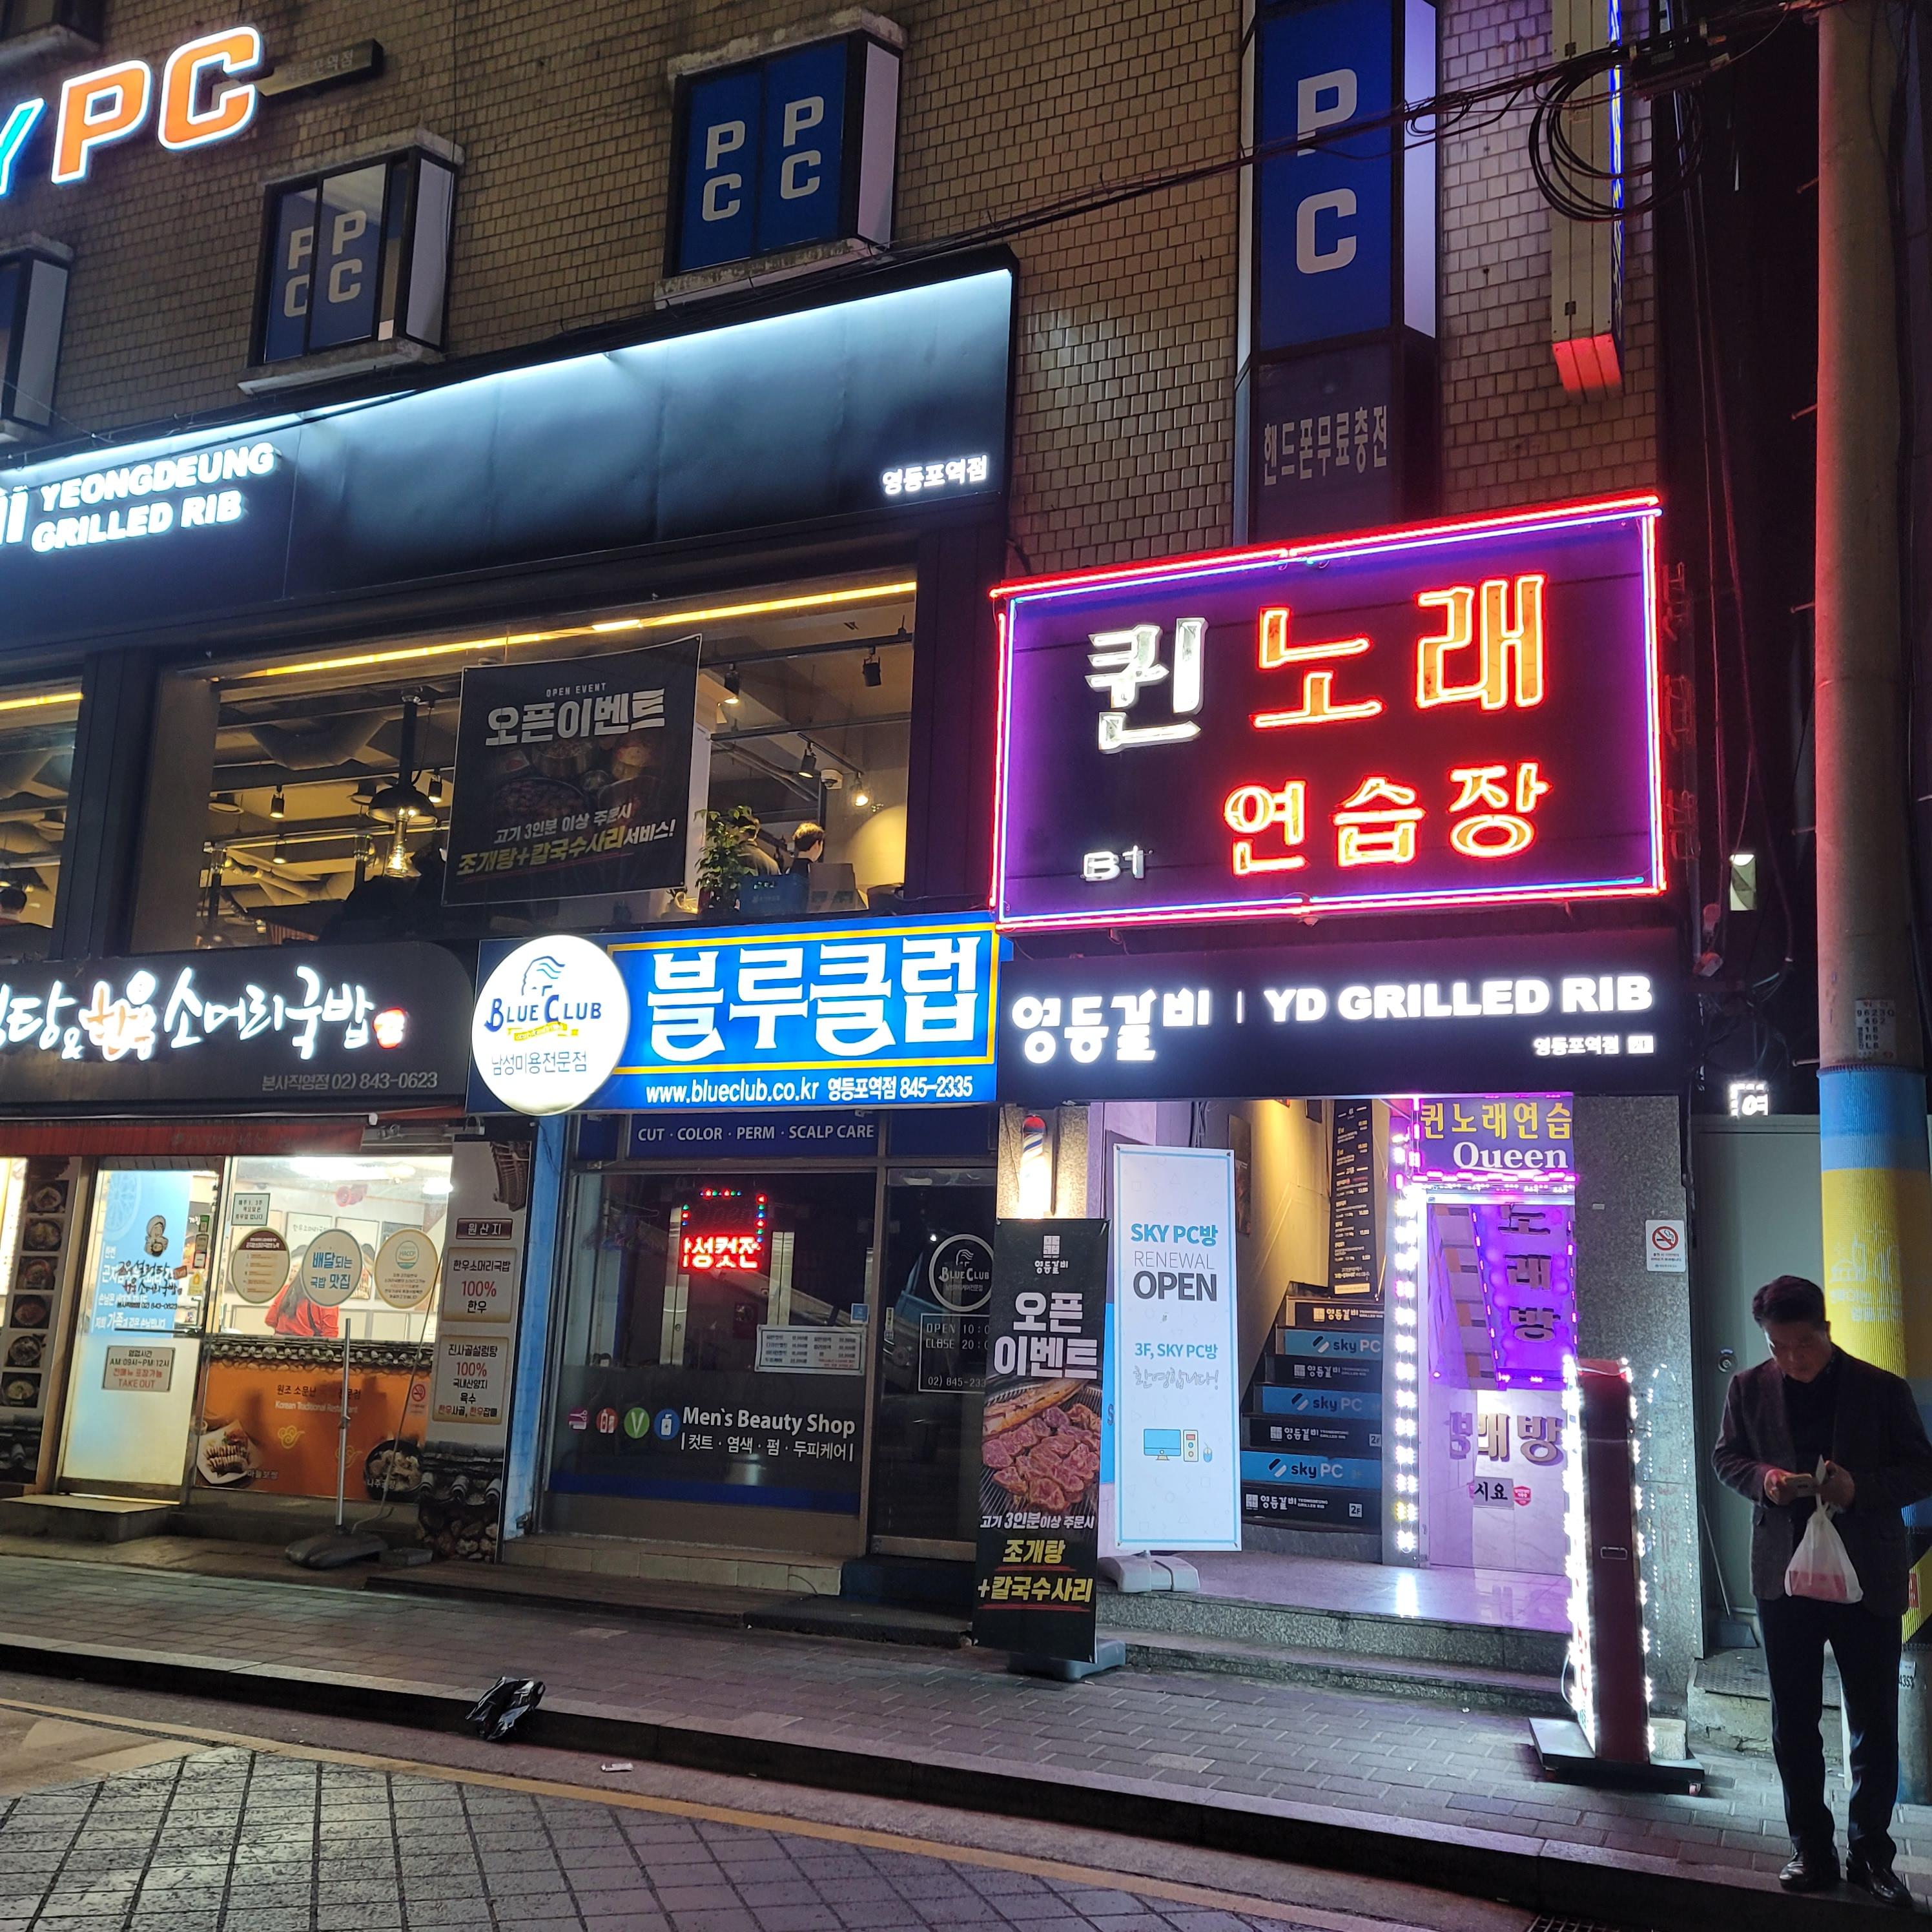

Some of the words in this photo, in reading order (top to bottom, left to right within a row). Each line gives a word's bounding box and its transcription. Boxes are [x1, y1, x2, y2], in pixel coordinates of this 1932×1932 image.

[52, 26, 261, 184] PC
[1263, 405, 1387, 486] 핸드폰무료충전
[40, 442, 276, 511] YEONGDEUNG
[882, 455, 987, 495] 영등포역점
[30, 501, 173, 553] GRILLED
[181, 489, 243, 528] RIB
[1085, 617, 1208, 754] 퀸
[1248, 571, 1548, 732] 노래
[546, 687, 571, 698] OPEN
[575, 683, 606, 694] EVENT
[485, 688, 665, 746] 오픈이벤트
[494, 827, 521, 844] 고기
[524, 818, 557, 839] 3인분
[562, 814, 590, 832] 이상
[593, 803, 632, 827] 주문시
[1223, 759, 1554, 877] 연습장
[1081, 845, 1149, 882] B1
[647, 937, 980, 1062] 블루클럽
[1264, 988, 1327, 1023] YD
[1338, 978, 1550, 1020] GRILLED
[1561, 976, 1652, 1013] RIB
[163, 967, 375, 1061] 소머리국밥
[491, 1051, 587, 1076] 남성미용전문점
[262, 1074, 329, 1093] 본사직영점
[332, 1074, 356, 1090] 02)
[359, 1072, 438, 1089] 843-0623
[646, 1076, 819, 1104] www.blueclub.co.kr
[827, 1076, 897, 1100] 영등포역점
[899, 1076, 973, 1099] 845-2335
[638, 1128, 665, 1142] CUT
[677, 1127, 723, 1141] COLOR
[736, 1127, 775, 1140] PERM
[788, 1125, 835, 1140] SCALP
[836, 1125, 874, 1138] CARE
[1454, 1141, 1568, 1169] Queen
[468, 1222, 502, 1236] 원산지
[1131, 1223, 1169, 1243] SKY
[1173, 1224, 1219, 1248] PC방
[313, 1251, 353, 1269] 배달되는
[453, 1260, 511, 1273] 한우소머리국밥
[1134, 1250, 1215, 1270] RENEWAL
[310, 1277, 327, 1289] 국밥
[329, 1273, 351, 1290] 맛집
[461, 1280, 497, 1297] 100%
[1133, 1271, 1218, 1302] OPEN
[467, 1299, 488, 1314] 한우
[1013, 1292, 1083, 1333] 오픈
[926, 1324, 956, 1334] OPEN
[963, 1324, 990, 1335] 10:0
[448, 1344, 498, 1357] 진사골설렁탕
[1134, 1342, 1155, 1360] 3F,
[1156, 1342, 1184, 1357] SKY
[1186, 1343, 1218, 1360] PC방
[1333, 1338, 1357, 1353] sky
[1359, 1339, 1381, 1353] PC
[994, 1336, 1098, 1379] 이벤트
[456, 1361, 487, 1377] 100%
[1133, 1365, 1219, 1390] 환영합니다!
[277, 1384, 292, 1395] 원조
[293, 1385, 316, 1397] 소문난
[453, 1379, 488, 1390] 국내산양지
[928, 1376, 943, 1387] 02)
[946, 1377, 986, 1388] 845-233
[275, 1400, 296, 1410] Korean
[297, 1402, 326, 1413] Traditional
[460, 1392, 476, 1404] 육수
[1313, 1395, 1337, 1412] sky
[1341, 1397, 1362, 1412] PC
[737, 1409, 803, 1436] Beauty
[807, 1413, 856, 1439] Shop
[727, 1435, 754, 1454] 염색
[766, 1438, 780, 1457] 펌
[1291, 1461, 1317, 1479] sky
[1321, 1463, 1343, 1478] PC
[980, 1515, 1002, 1529] 고기
[1063, 1516, 1095, 1530] 주문시
[1002, 1539, 1065, 1564] 조개탕
